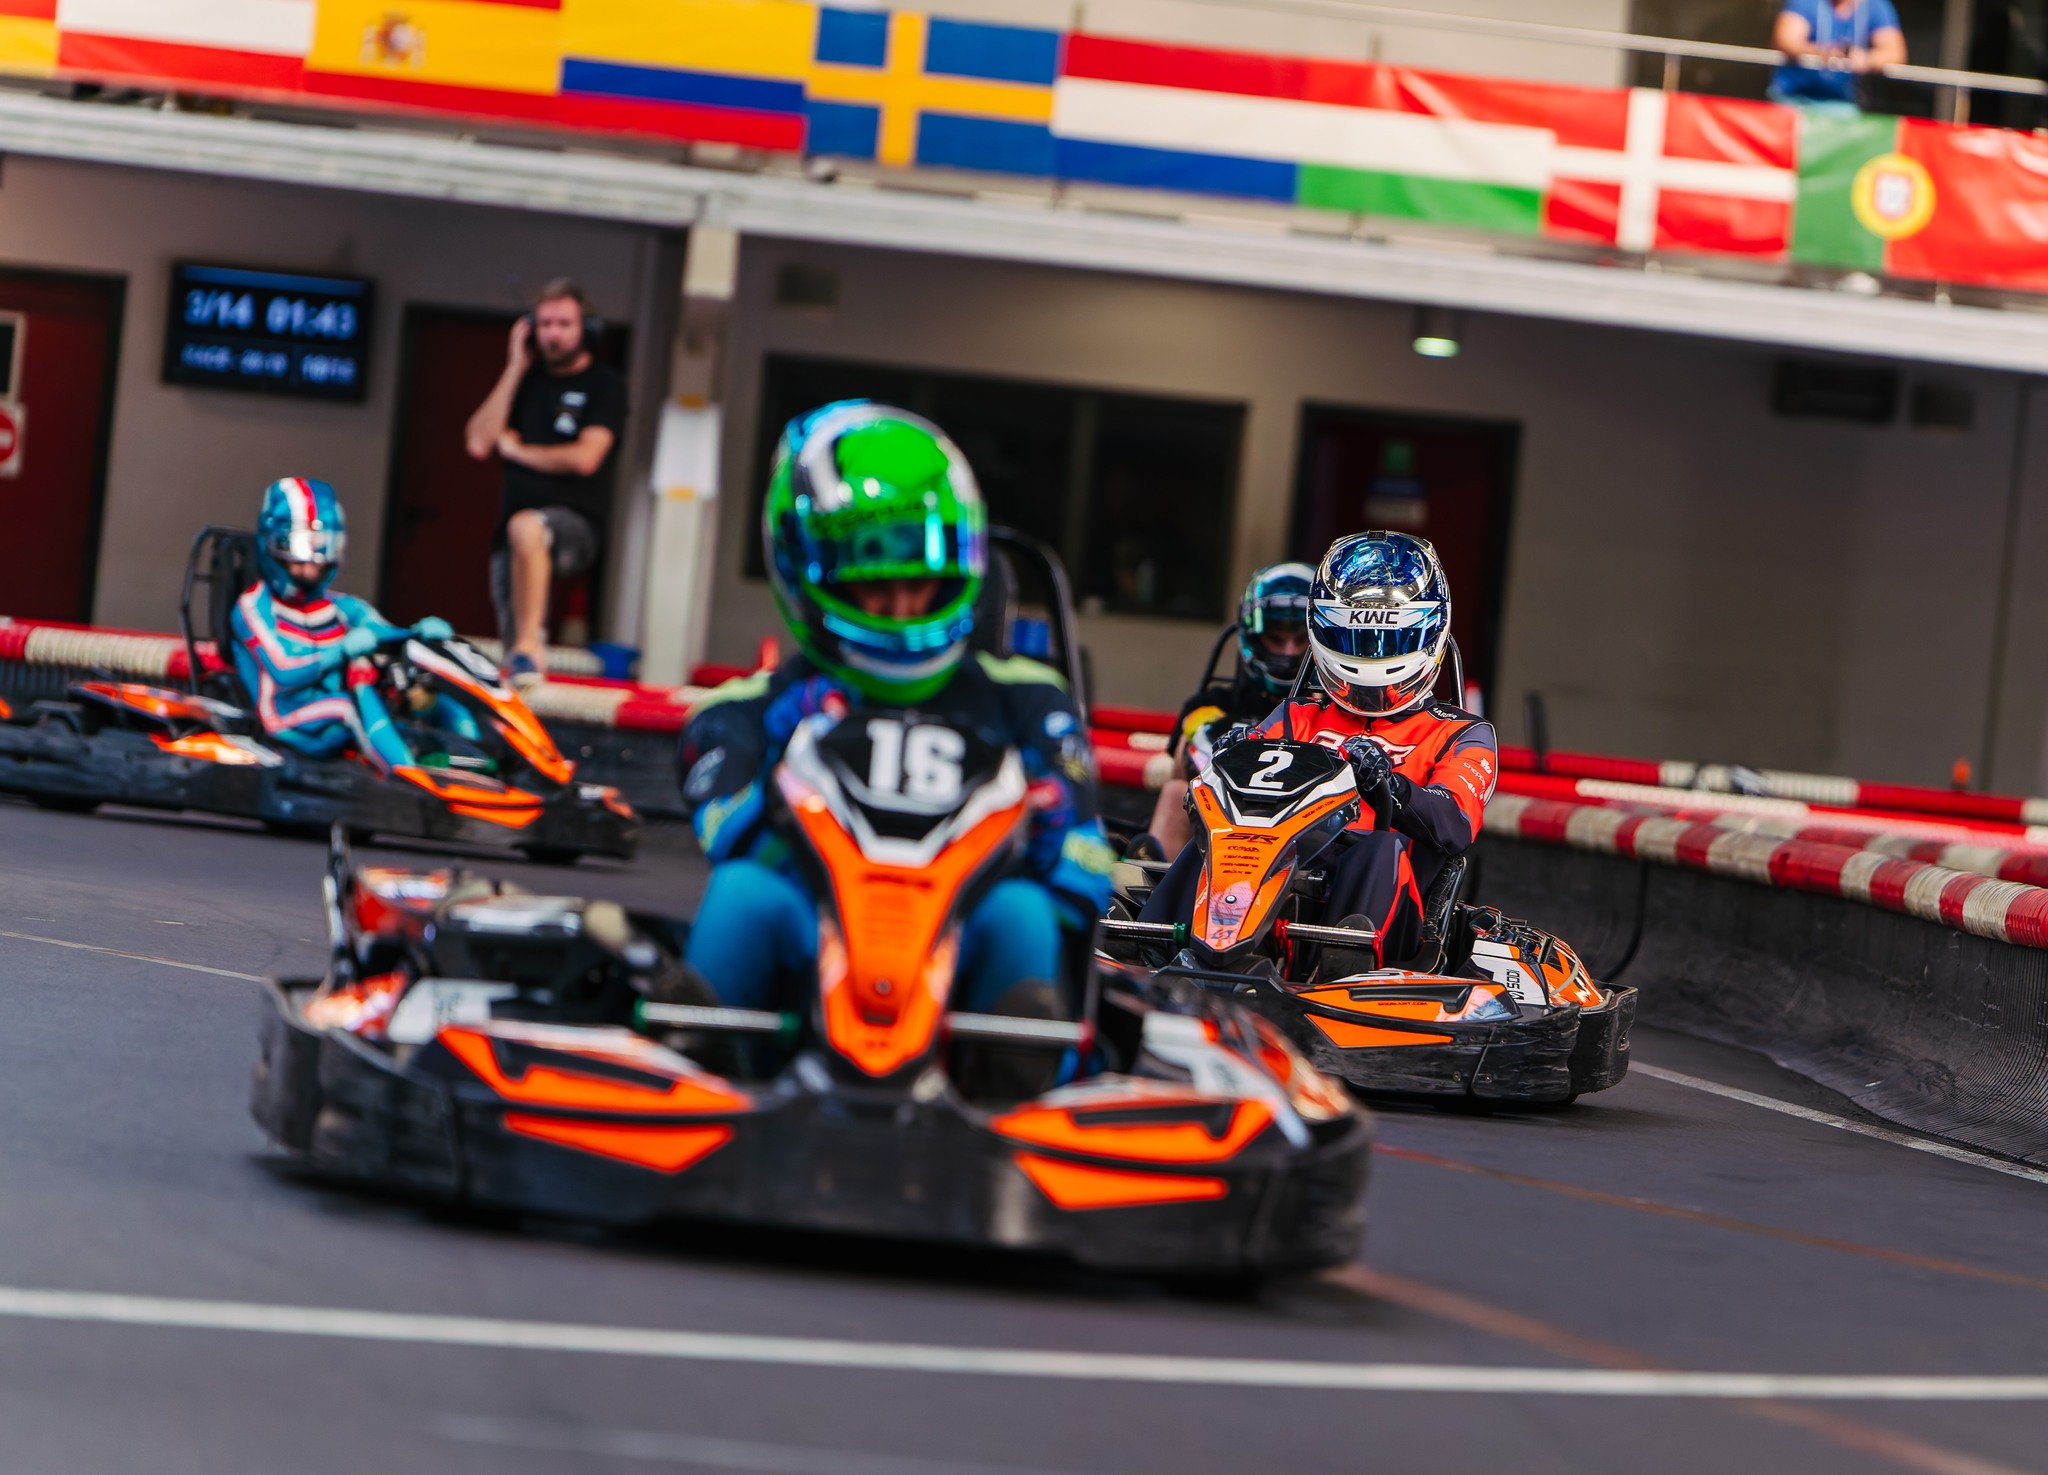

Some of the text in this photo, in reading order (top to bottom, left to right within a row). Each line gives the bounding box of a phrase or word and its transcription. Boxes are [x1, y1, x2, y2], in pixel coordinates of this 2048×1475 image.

[1349, 610, 1400, 625] KWC
[865, 718, 966, 805] 16
[1248, 750, 1294, 790] 2
